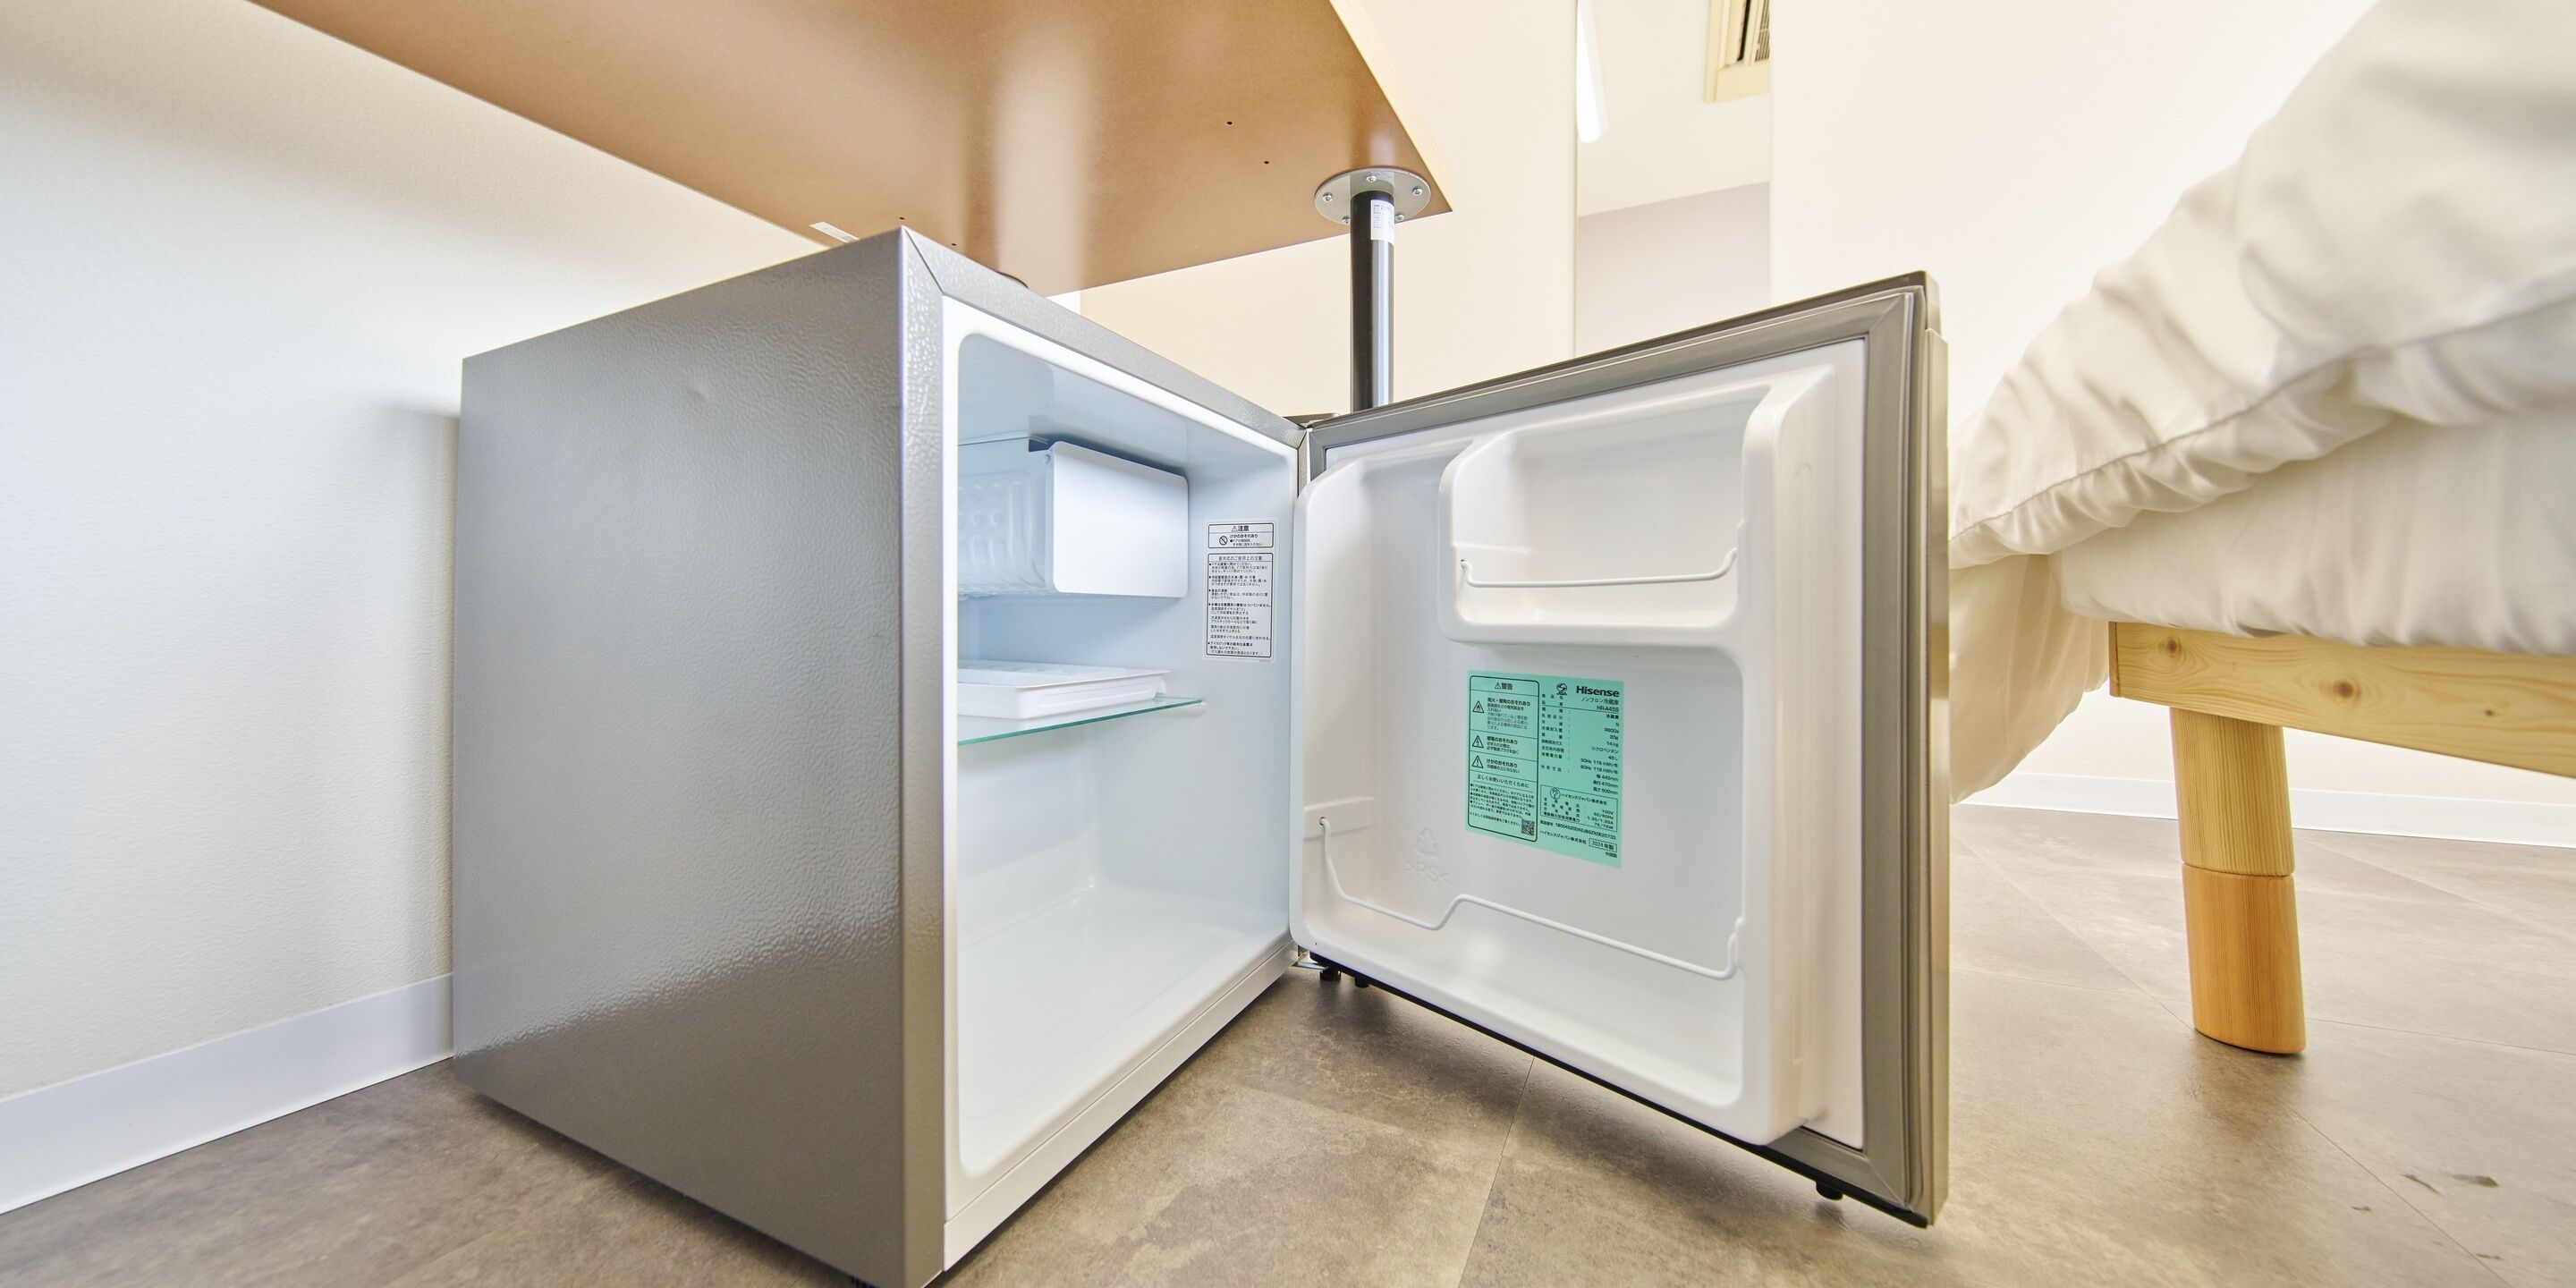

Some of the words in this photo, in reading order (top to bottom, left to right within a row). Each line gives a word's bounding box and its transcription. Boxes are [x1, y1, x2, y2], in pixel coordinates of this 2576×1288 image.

[1576, 685, 1620, 698] Hisense
[1477, 774, 1530, 788] 正しくお使いいただくために
